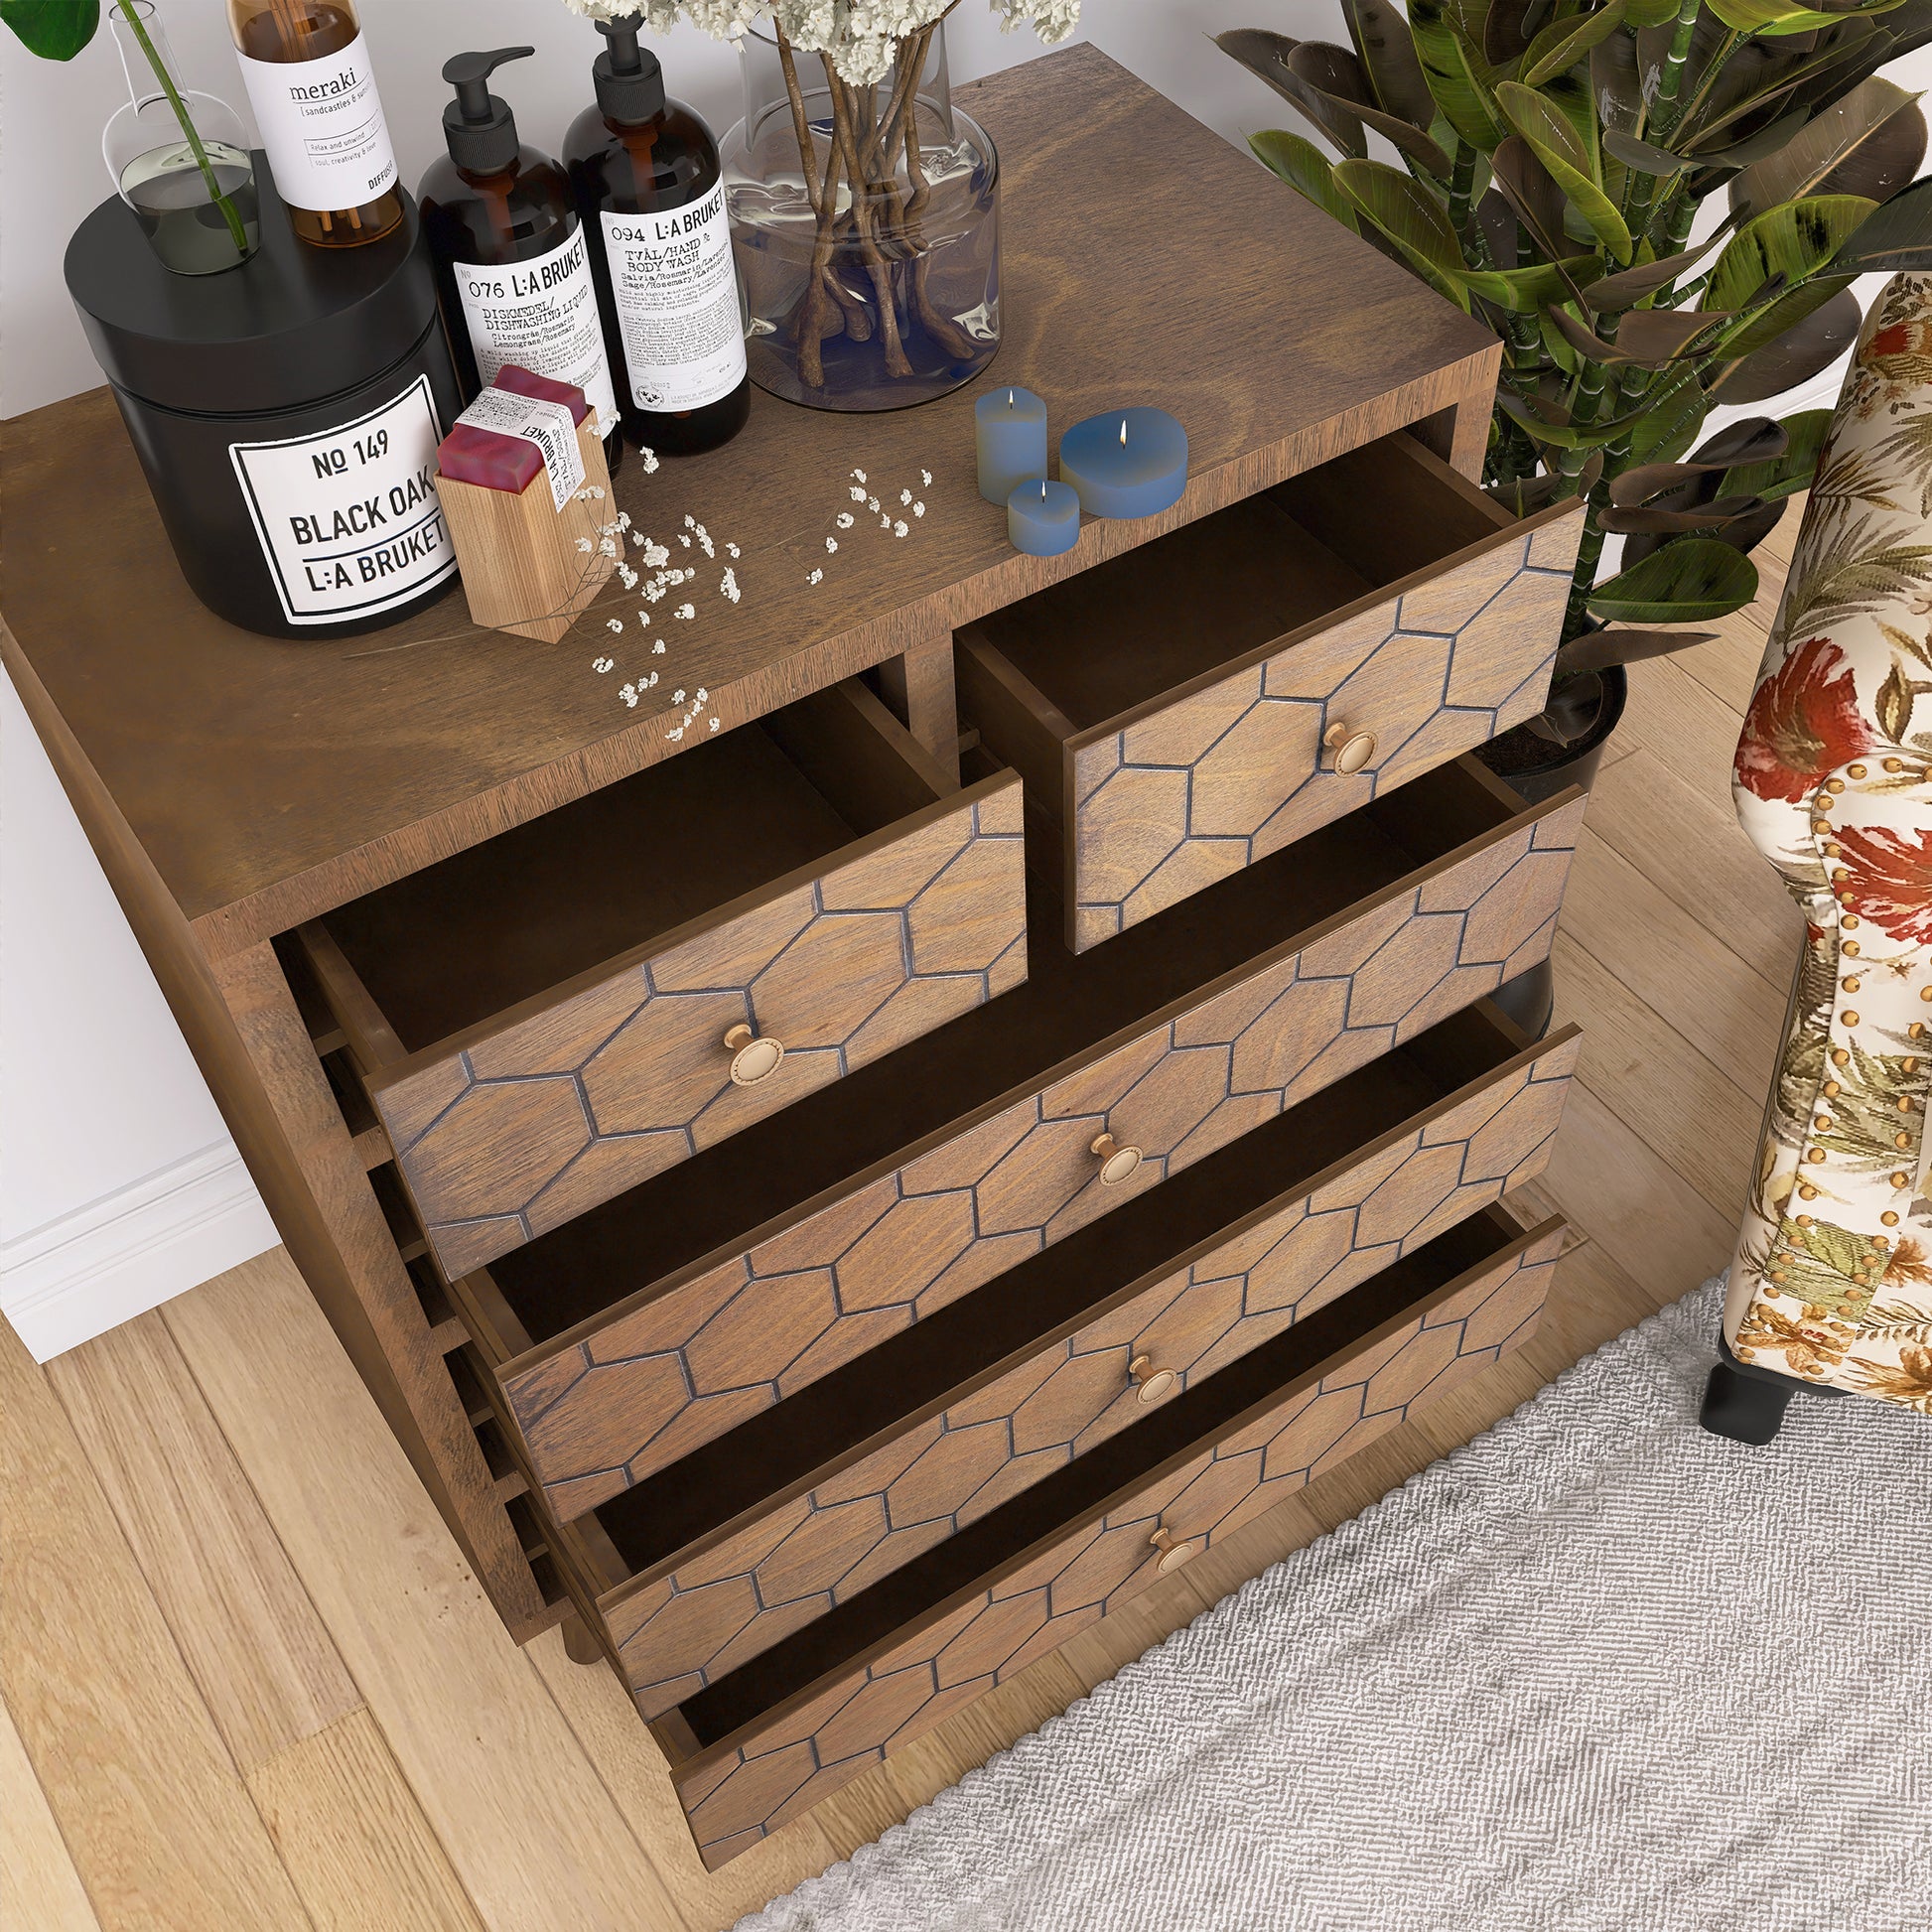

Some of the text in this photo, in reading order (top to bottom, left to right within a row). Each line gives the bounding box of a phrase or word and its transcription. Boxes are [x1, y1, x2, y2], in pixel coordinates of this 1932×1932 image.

[289, 67, 356, 100] meraki
[330, 141, 343, 150] and
[344, 131, 365, 146] unwind
[331, 151, 361, 165] creativity
[612, 187, 724, 242] 094 L:A BRUKET
[624, 232, 711, 261] TVÅL/HAND &
[626, 250, 700, 273] BODY WASH
[469, 235, 585, 299] 076 L:A BRUKET
[482, 296, 555, 320] DISKMEDEL/
[484, 308, 561, 331] DISHWASHING
[562, 284, 589, 315] LIQUID
[352, 428, 388, 466] 149
[520, 425, 555, 462] BRUKET
[289, 465, 435, 545] BLACK OAK
[304, 513, 445, 592] L:A BRUKET
